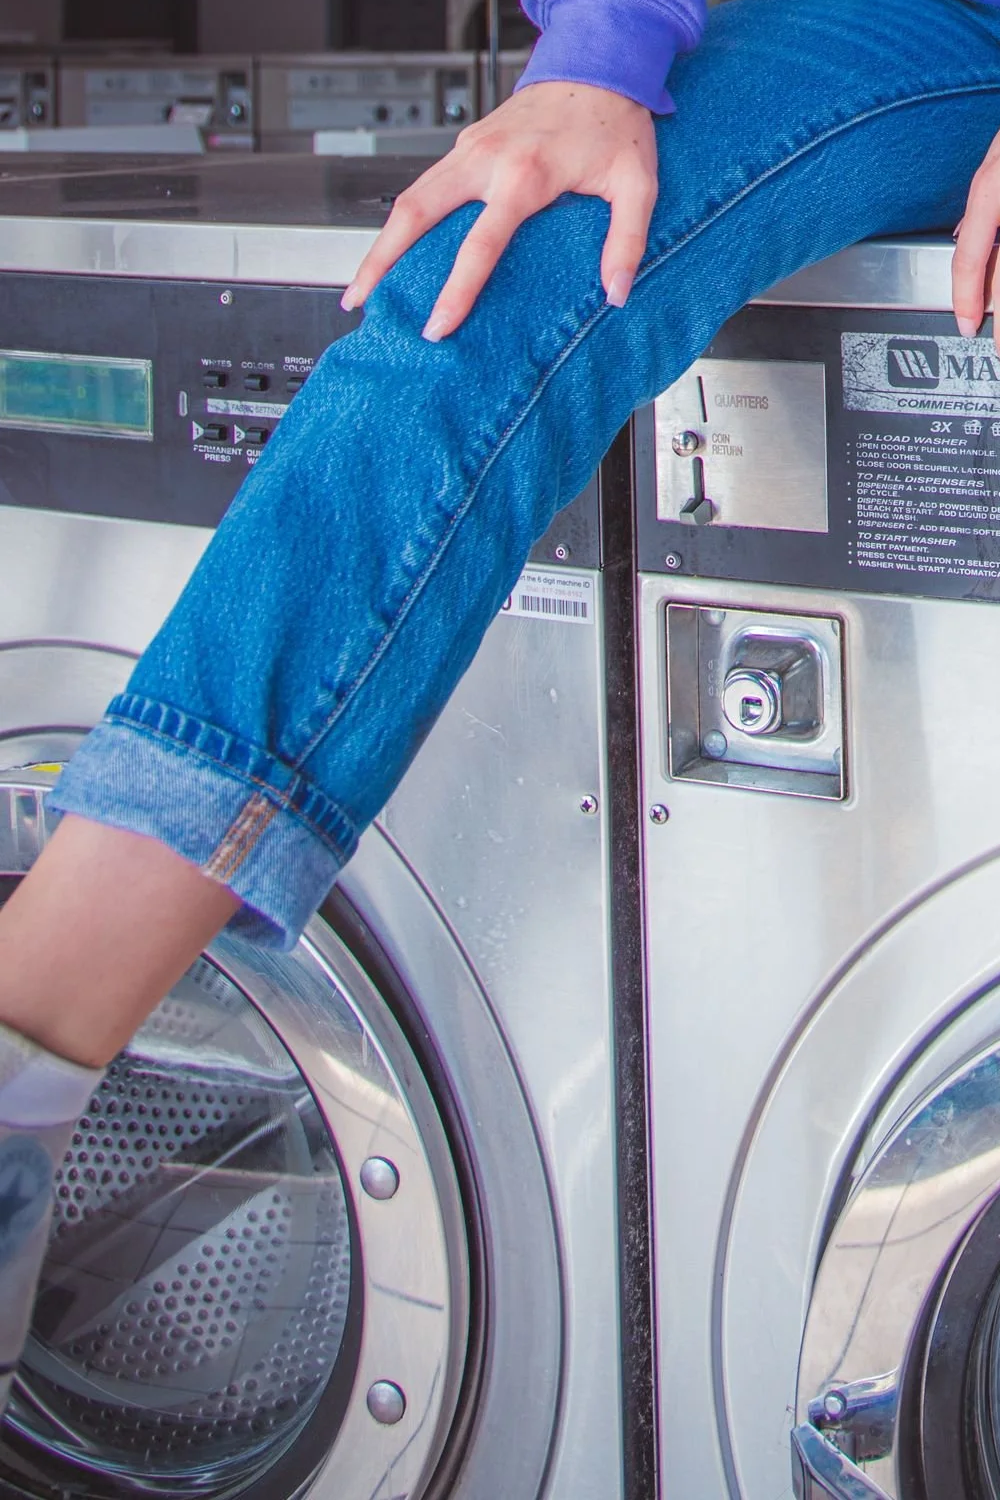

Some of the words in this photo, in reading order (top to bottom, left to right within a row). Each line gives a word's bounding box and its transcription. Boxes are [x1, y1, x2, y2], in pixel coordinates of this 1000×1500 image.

[201, 358, 232, 368] WHITES
[241, 362, 275, 370] COLORS
[283, 364, 314, 372] COLOR
[715, 395, 769, 409] QUARTERS
[897, 398, 999, 413] COMMERCIAL
[930, 421, 952, 433] 3X
[712, 433, 730, 443] COIN
[876, 435, 910, 443] LOAD
[914, 436, 968, 446] WASHER
[194, 445, 242, 456] PERMANENT
[712, 445, 743, 457] RETURN
[921, 446, 957, 454] PULLING
[960, 449, 998, 457] HANDLE.
[205, 454, 231, 462] PRESS
[882, 453, 923, 461] CLOTHES.
[856, 460, 884, 468] CLOSE
[913, 464, 959, 473] SECURELY,
[857, 472, 873, 480] TO
[876, 474, 902, 482] FILL
[905, 476, 985, 488] DISPENSERS
[857, 481, 905, 490] DISPENSER
[919, 485, 937, 493] ADD
[939, 487, 991, 496] DETERGENT
[870, 489, 900, 497] CYCLE.
[857, 497, 905, 506] DISPENSER
[939, 503, 988, 512] POWDERED
[857, 511, 889, 519] DURING
[959, 511, 987, 519] LIQUID
[857, 520, 905, 529] DISPENSER
[940, 526, 971, 534] FABRIC
[874, 533, 908, 542] START
[911, 536, 956, 546] WASHER
[889, 544, 930, 553] PAYMENT.
[857, 551, 885, 559] PRESS
[887, 553, 915, 561] CYCLE
[917, 556, 951, 565] BUTTON
[858, 560, 894, 569] WASHER
[896, 562, 917, 570] WILL
[918, 565, 945, 573] START
[557, 579, 581, 587] machine
